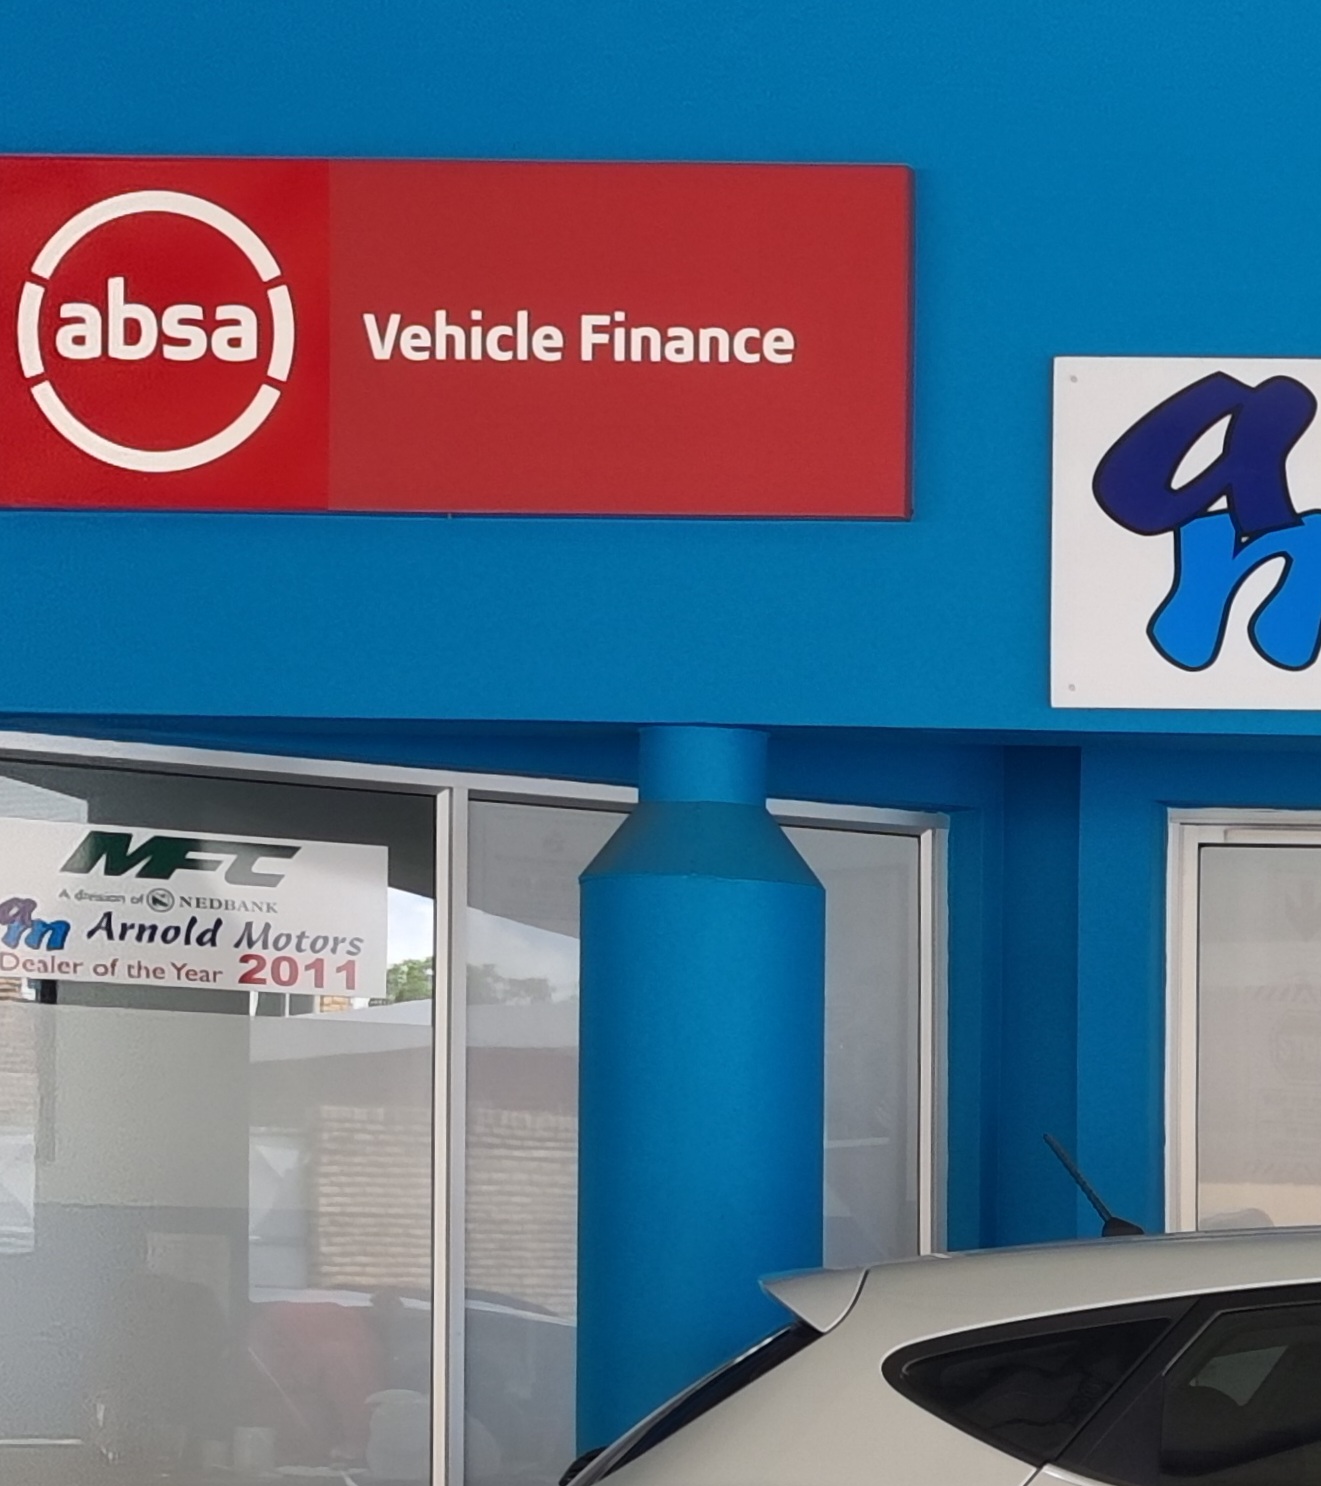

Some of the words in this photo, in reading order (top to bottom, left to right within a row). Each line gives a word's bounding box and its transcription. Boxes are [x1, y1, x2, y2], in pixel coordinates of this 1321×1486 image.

[55, 276, 258, 361] absa
[363, 310, 563, 363] Vehicle
[580, 311, 795, 364] Finance
[60, 831, 301, 888] MFC
[58, 889, 71, 900] A
[179, 896, 279, 914] NEDBANK
[86, 911, 223, 947] Arnold
[234, 921, 364, 956] Motors
[0, 952, 83, 975] Dealer
[93, 958, 119, 977] of
[127, 960, 165, 980] the
[171, 962, 223, 983] Year
[238, 953, 357, 990] 2011
